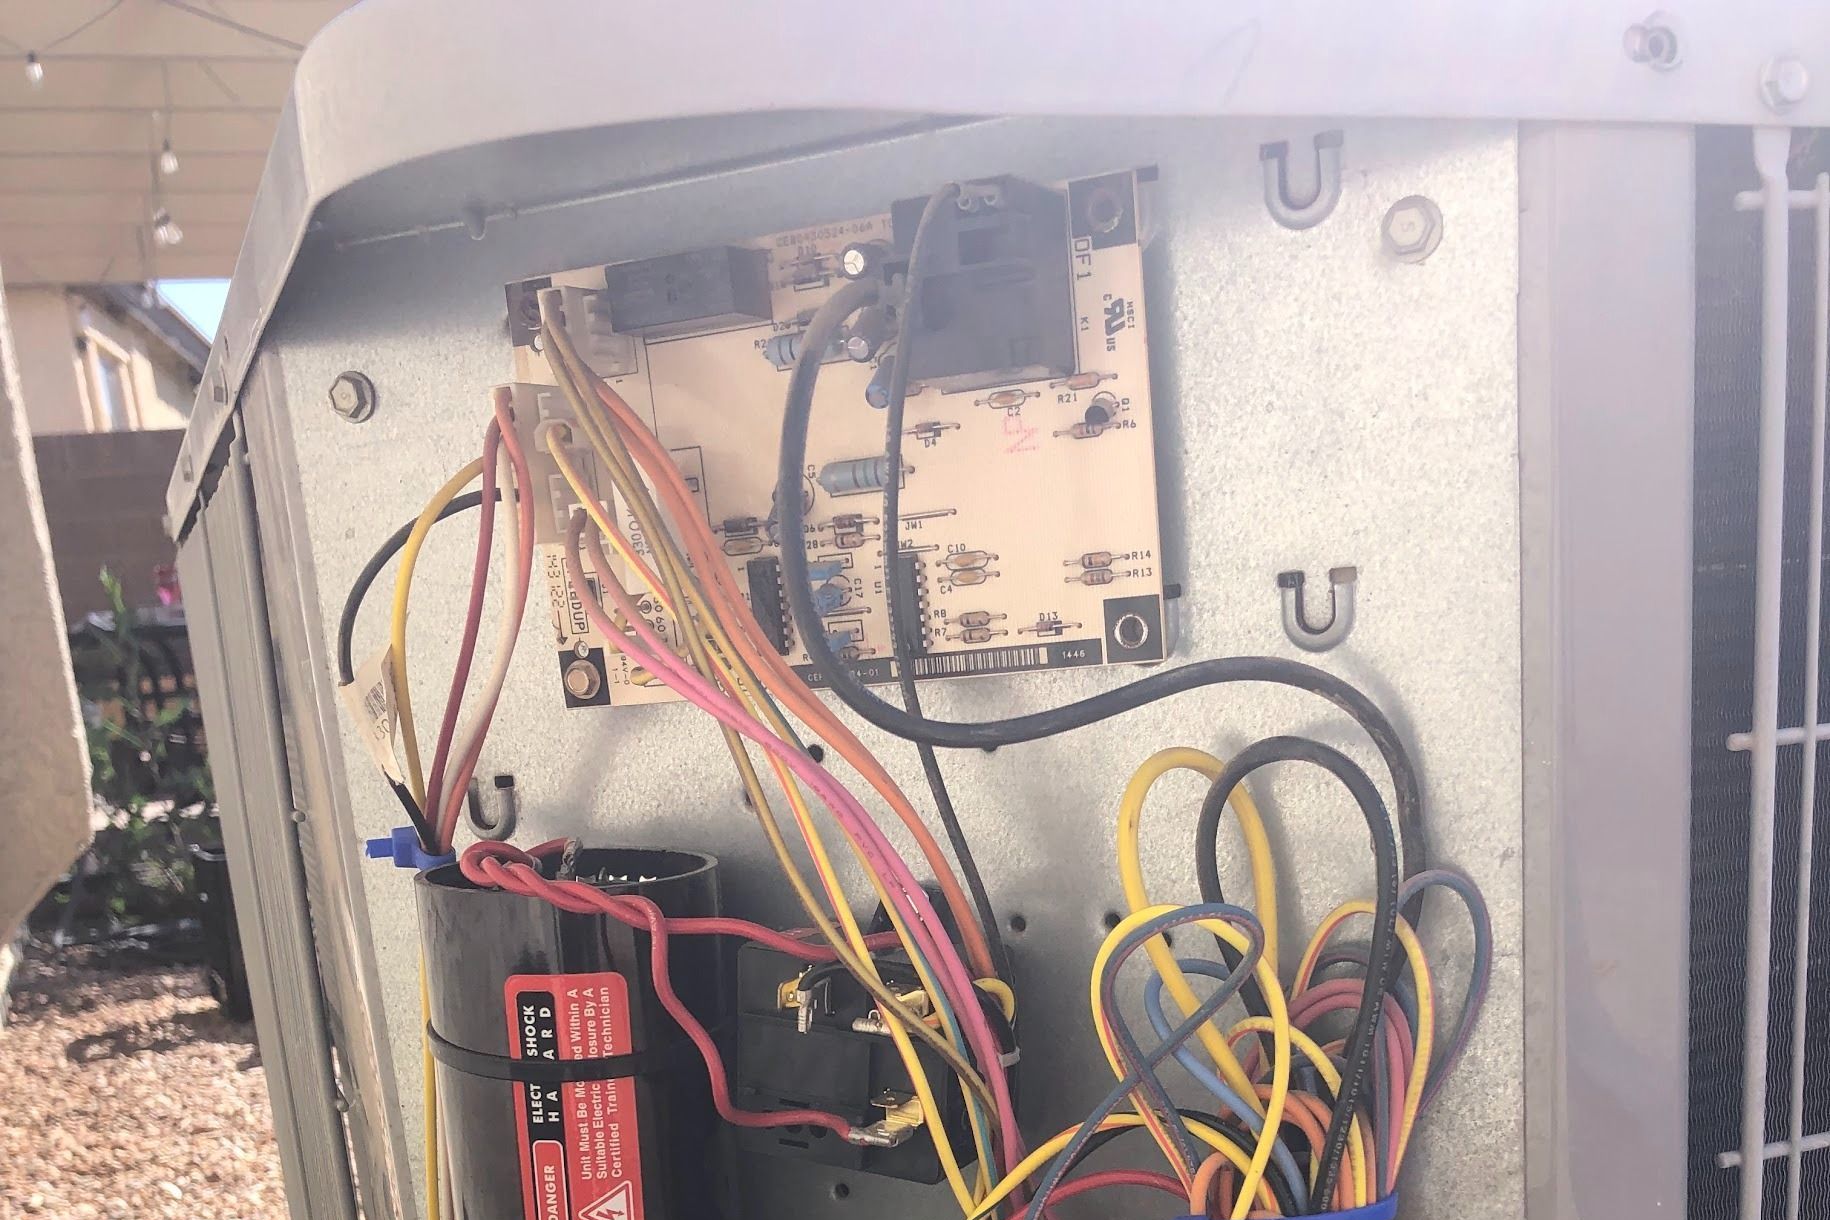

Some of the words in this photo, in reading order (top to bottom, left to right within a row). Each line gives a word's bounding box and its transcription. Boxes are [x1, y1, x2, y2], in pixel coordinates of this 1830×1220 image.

[1057, 393, 1078, 404] R21
[1007, 406, 1021, 417] C2
[1122, 420, 1137, 429] R6
[924, 438, 937, 448] D4
[806, 464, 816, 479] C5
[905, 521, 923, 531] JW1
[947, 543, 966, 553] C10
[1131, 550, 1152, 560] R14
[1132, 568, 1153, 577] R13
[854, 578, 864, 598] C17
[940, 585, 953, 595] C4
[933, 609, 947, 619] R8
[1039, 612, 1059, 621] D13
[934, 627, 948, 637] R7
[1062, 649, 1086, 660] 1446
[567, 988, 579, 998] A
[583, 987, 595, 998] A
[584, 1000, 597, 1017] By
[568, 1003, 582, 1042] Within
[598, 986, 614, 1059] Technician
[523, 1005, 539, 1057] SHOCK
[576, 1102, 588, 1119] Be
[577, 1121, 591, 1153] Must
[592, 1129, 608, 1180] Suitable
[608, 1122, 623, 1178] Certified
[581, 1155, 593, 1180] Unit
